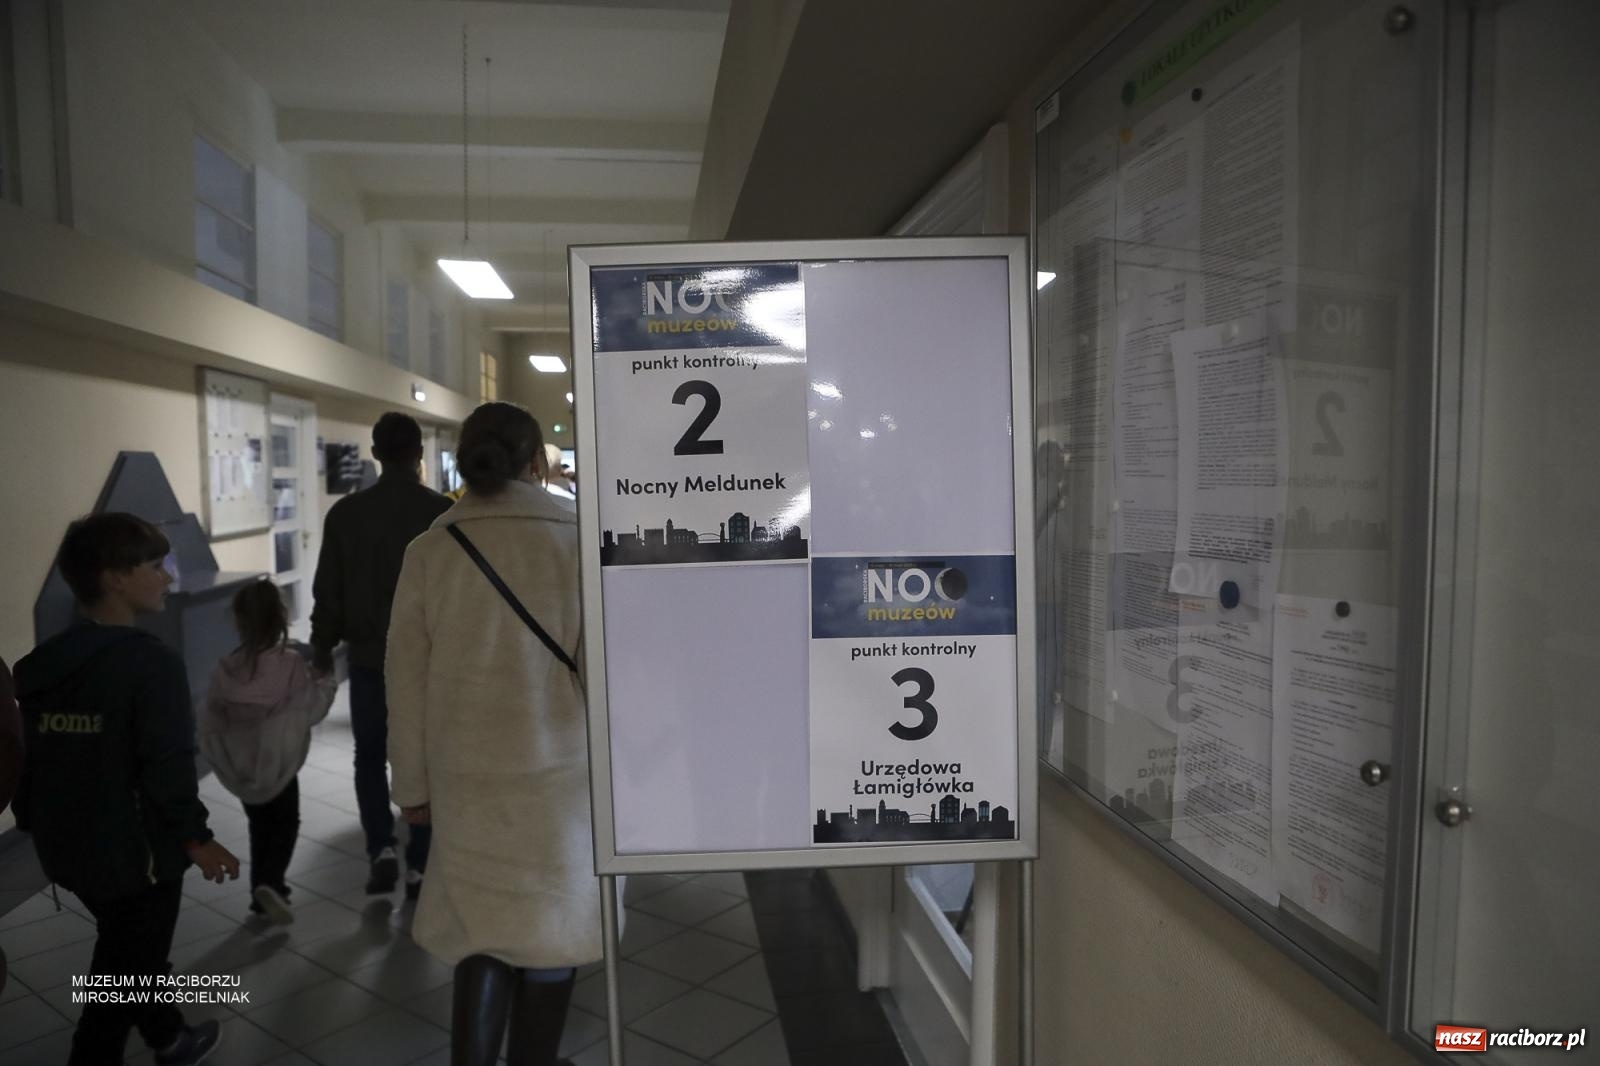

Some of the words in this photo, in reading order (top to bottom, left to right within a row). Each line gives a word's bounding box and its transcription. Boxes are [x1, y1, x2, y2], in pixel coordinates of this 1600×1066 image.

[647, 315, 737, 334] muzeów
[632, 354, 679, 375] punkt
[671, 379, 724, 456] 2
[616, 477, 679, 499] Nocny
[684, 472, 787, 494] Meldunek
[867, 602, 956, 622] muzeów
[851, 642, 898, 661] punkt
[902, 640, 977, 660] kontrolny
[888, 667, 939, 741] 3
[861, 758, 961, 780] Urzędowa
[853, 776, 974, 800] Łamigłówka
